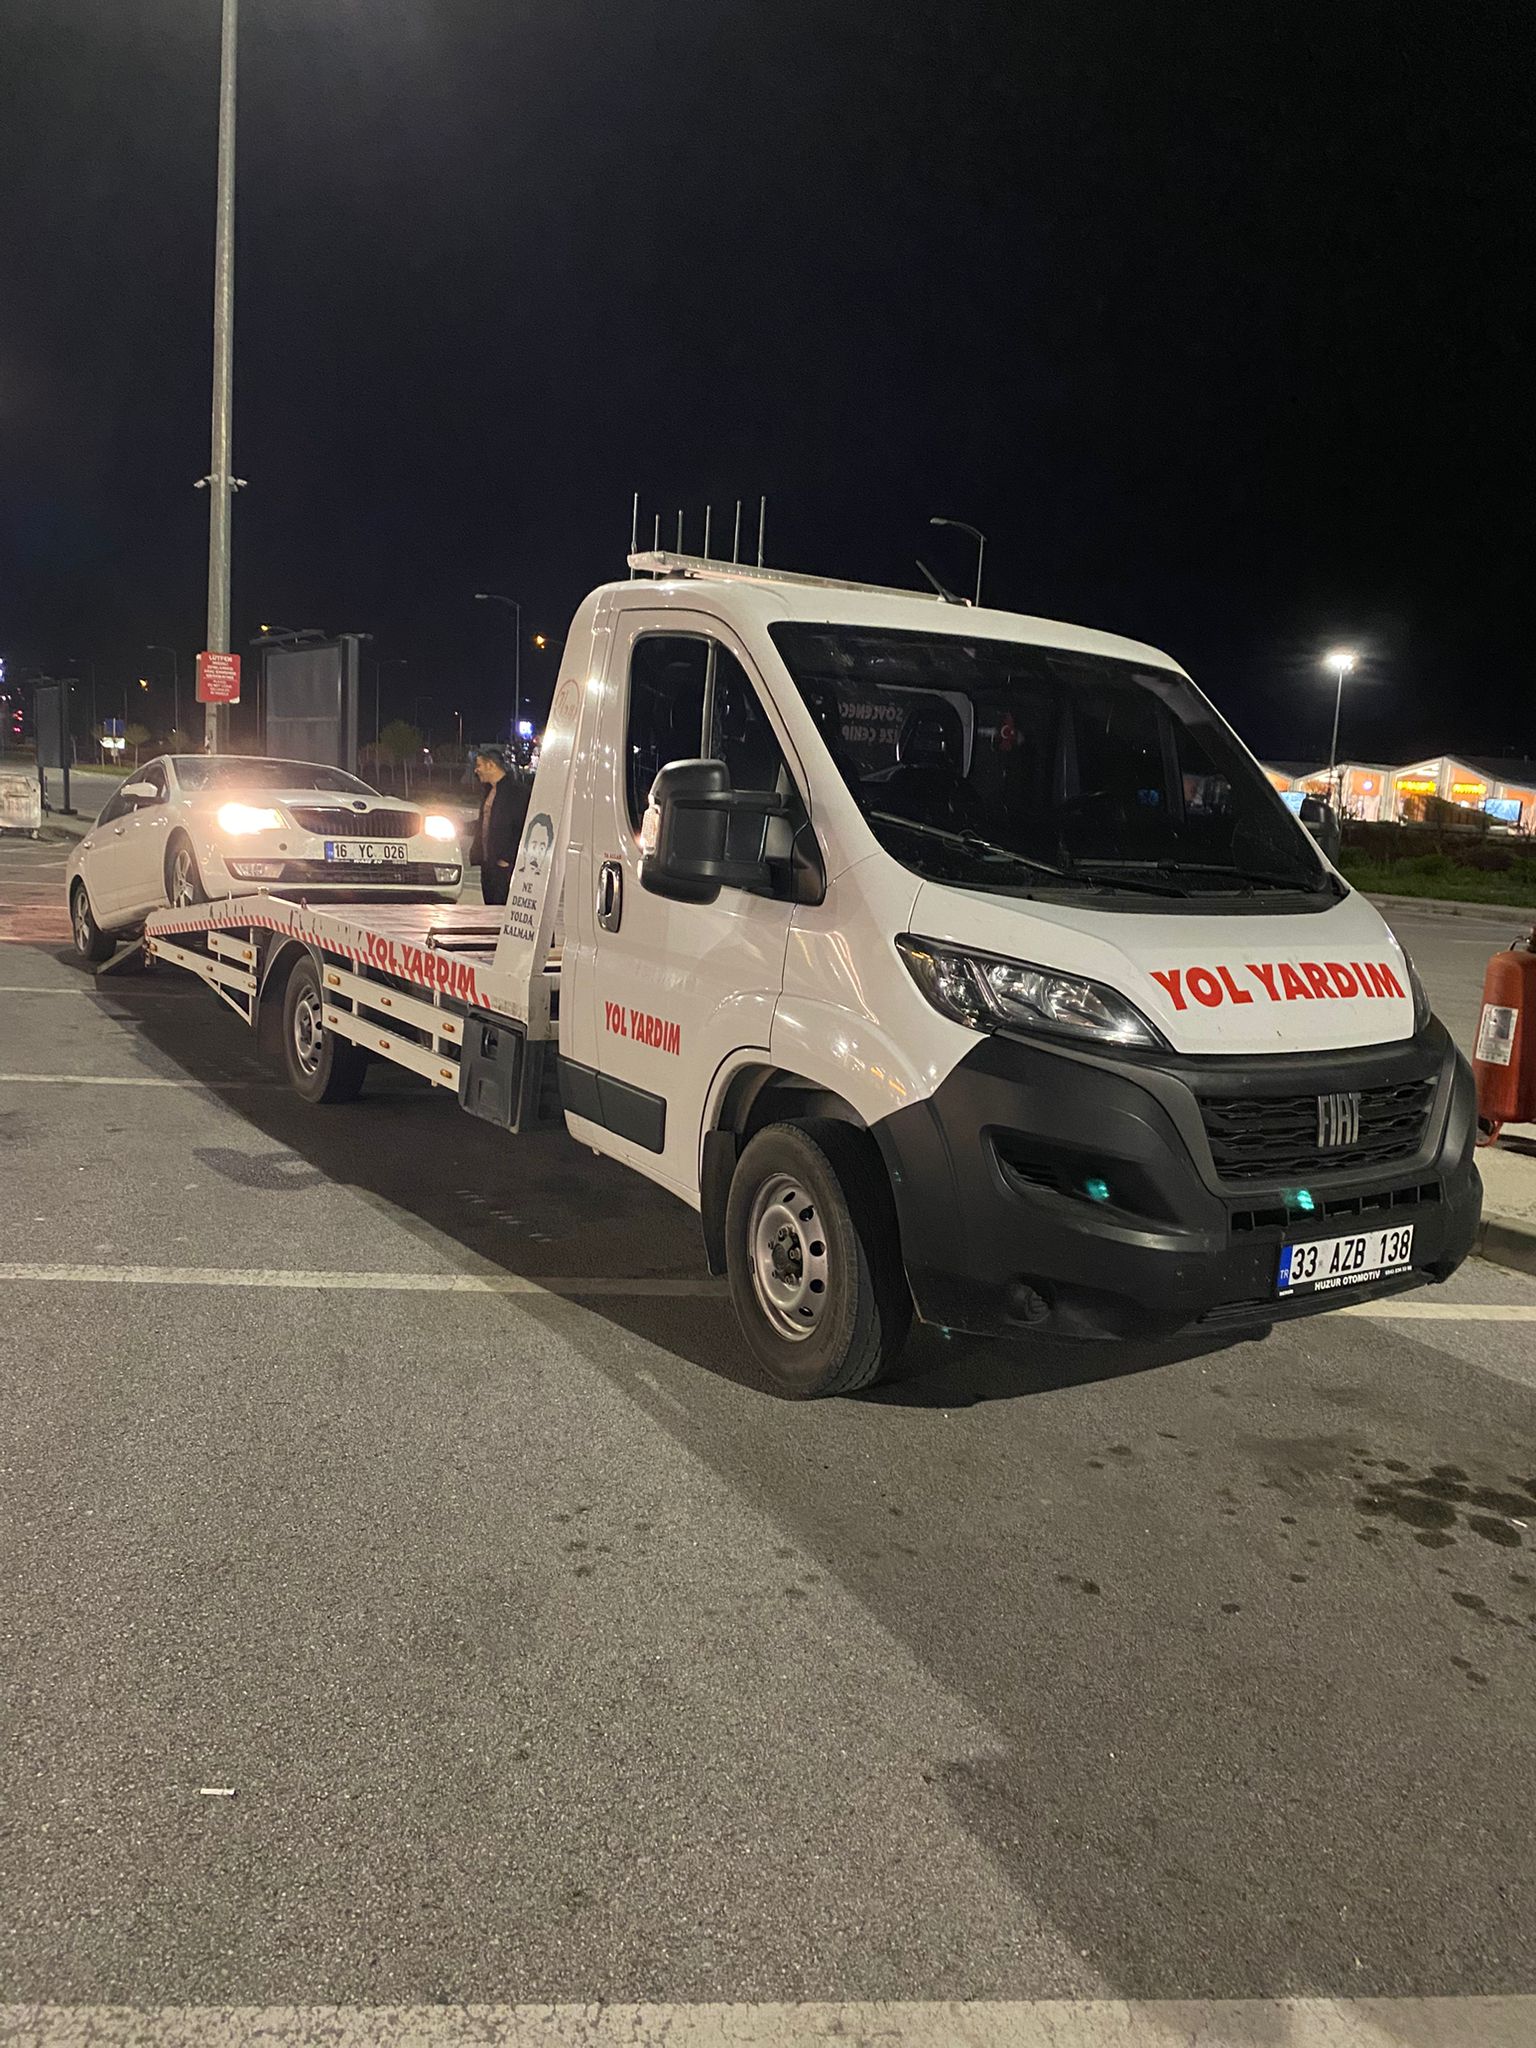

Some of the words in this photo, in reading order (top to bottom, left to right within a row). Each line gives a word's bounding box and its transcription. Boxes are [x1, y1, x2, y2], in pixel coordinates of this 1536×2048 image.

[335, 844, 347, 858] 16
[359, 844, 374, 858] YC
[383, 845, 405, 859] 026
[521, 882, 534, 893] NE
[511, 895, 538, 911] DEMEK
[510, 910, 534, 927] YOLDA
[502, 924, 536, 942] KALMAM
[365, 931, 398, 966] YOL
[401, 943, 476, 995] YARDIM
[1149, 965, 1254, 1011] YOL
[1245, 962, 1406, 1001] YARDIM
[605, 1000, 627, 1037] YOL
[630, 1008, 681, 1056] YARDIM
[1318, 1092, 1361, 1147] FIAT
[1292, 1246, 1318, 1280] 33
[1329, 1238, 1366, 1274] AZB
[1380, 1229, 1410, 1264] 138
[1280, 1269, 1289, 1279] TR
[1314, 1279, 1342, 1291] HUZUR
